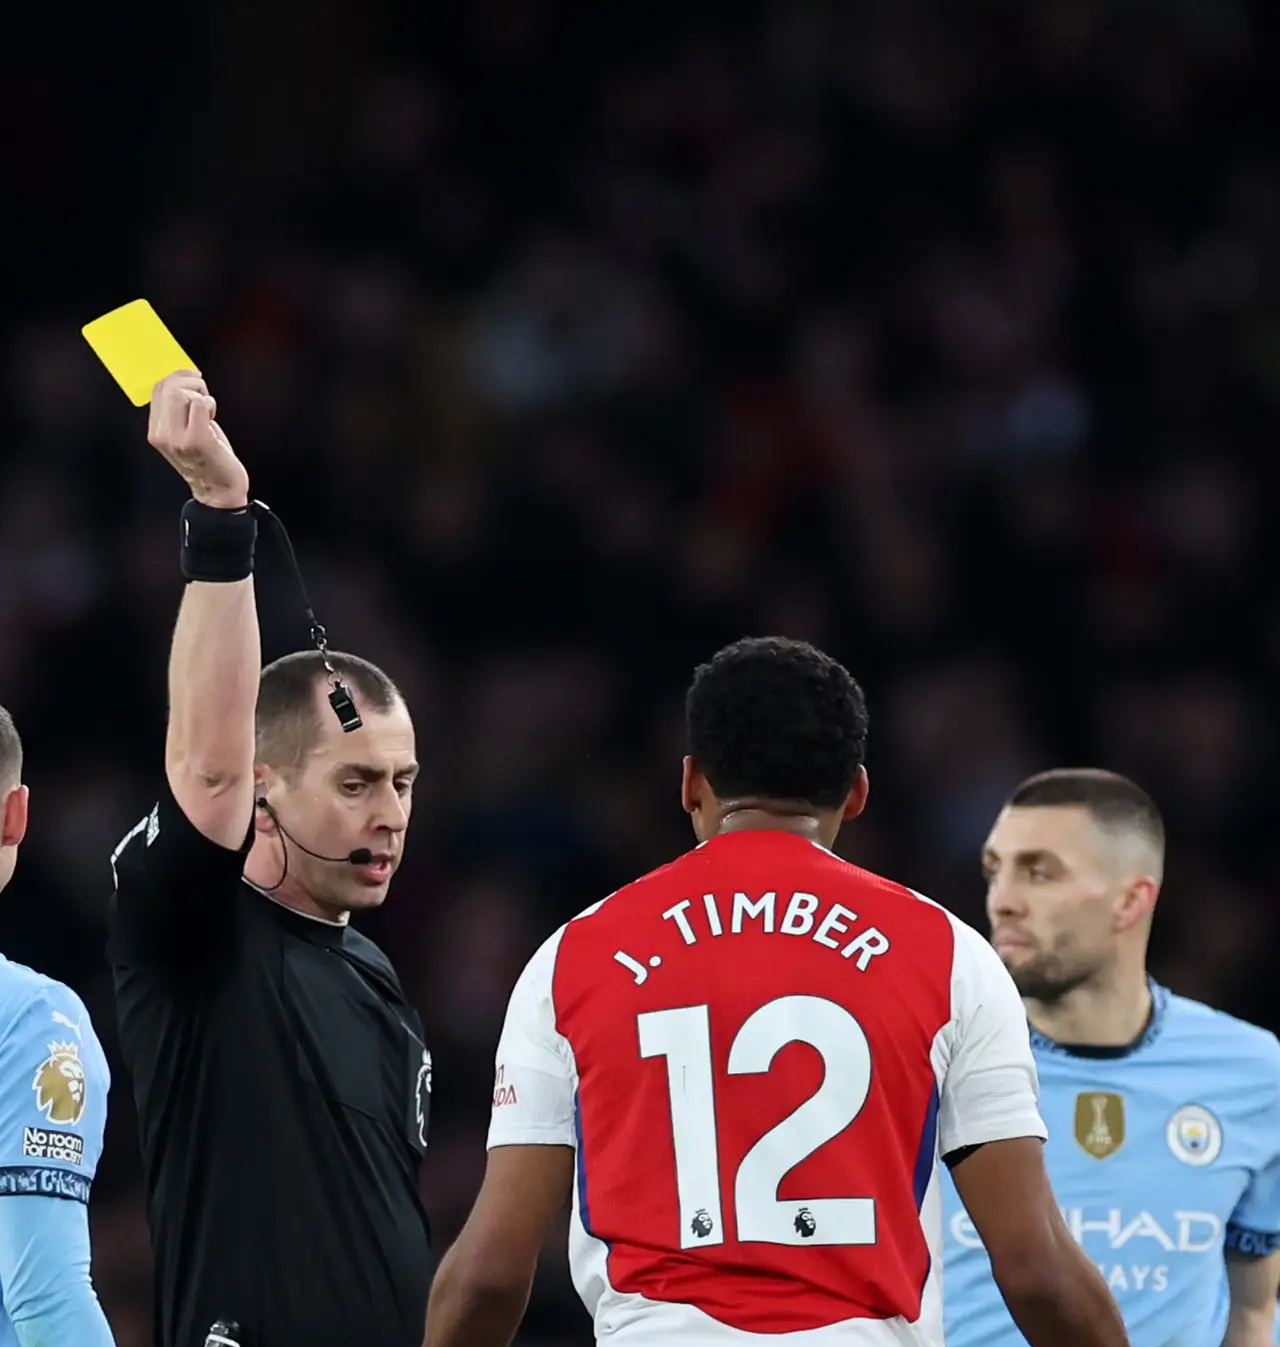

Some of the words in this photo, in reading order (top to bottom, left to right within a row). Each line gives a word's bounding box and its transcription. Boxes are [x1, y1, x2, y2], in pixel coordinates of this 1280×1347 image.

[613, 949, 662, 986] J.
[662, 891, 891, 972] TIMBER
[23, 1127, 48, 1145] No
[49, 1133, 83, 1151] room
[636, 993, 877, 1250] 12
[949, 1207, 1221, 1253] EHAD
